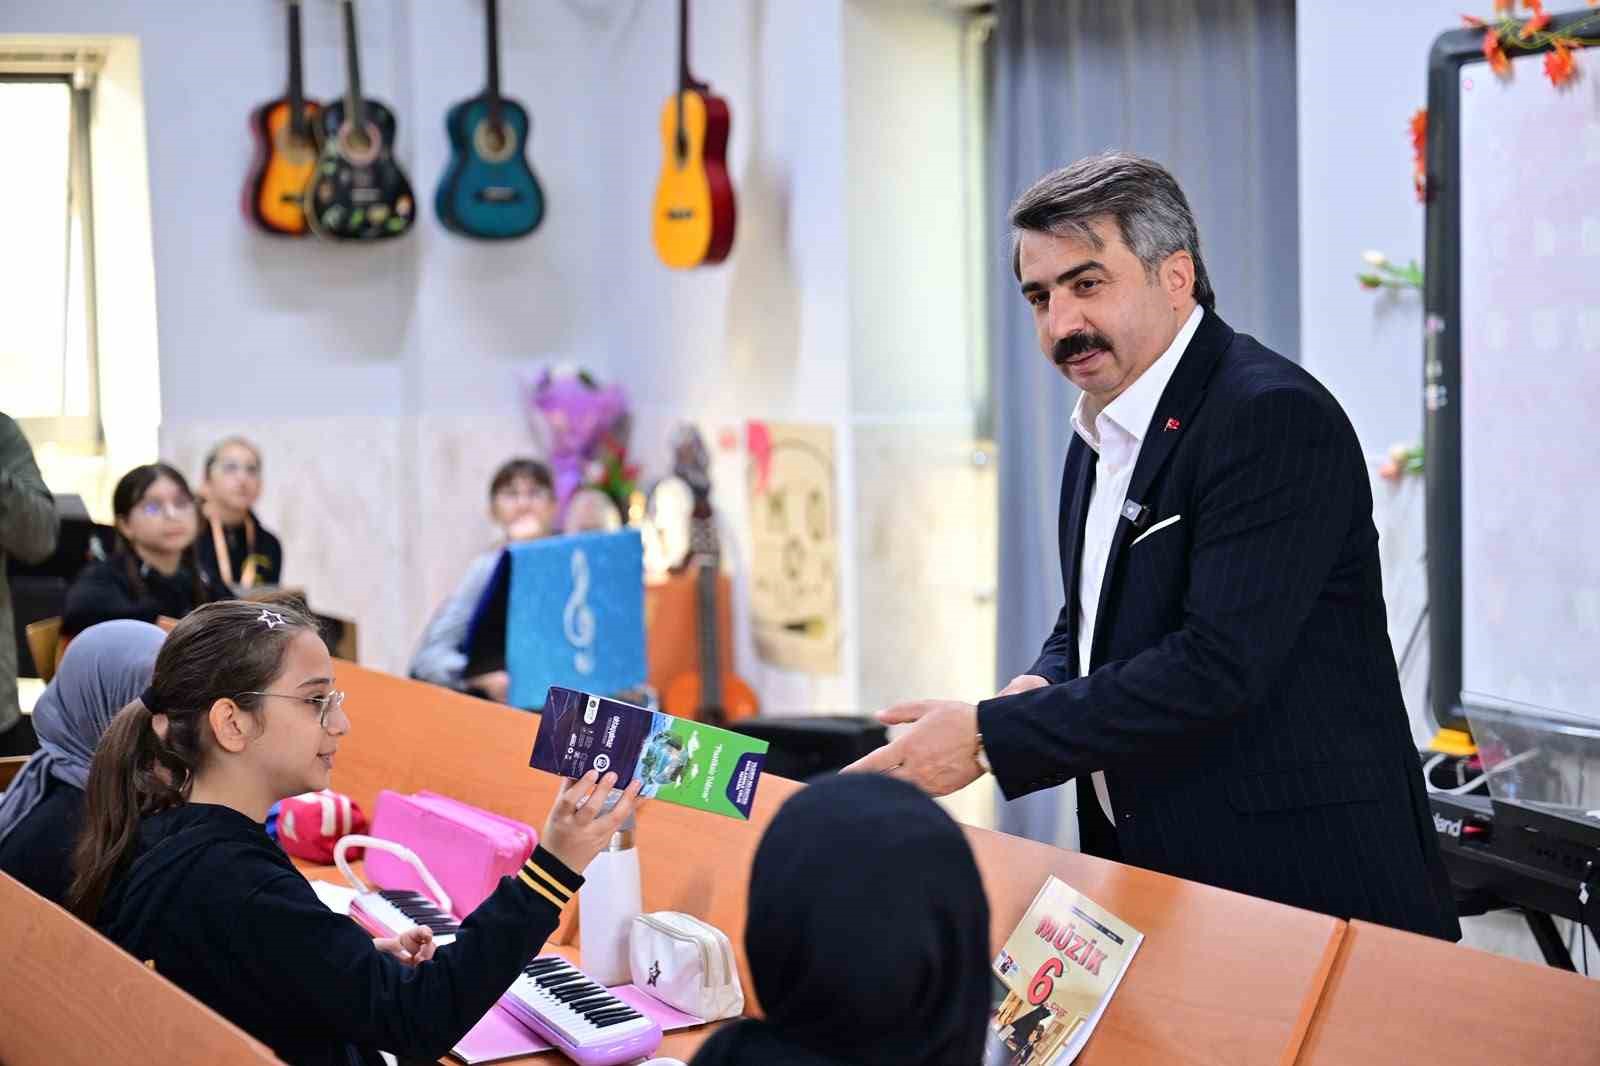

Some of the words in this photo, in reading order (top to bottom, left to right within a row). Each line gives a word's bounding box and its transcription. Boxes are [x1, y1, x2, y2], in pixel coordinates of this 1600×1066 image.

[1432, 812, 1462, 837] land
[1034, 916, 1107, 976] MÜZİK
[1027, 957, 1064, 1006] 6
